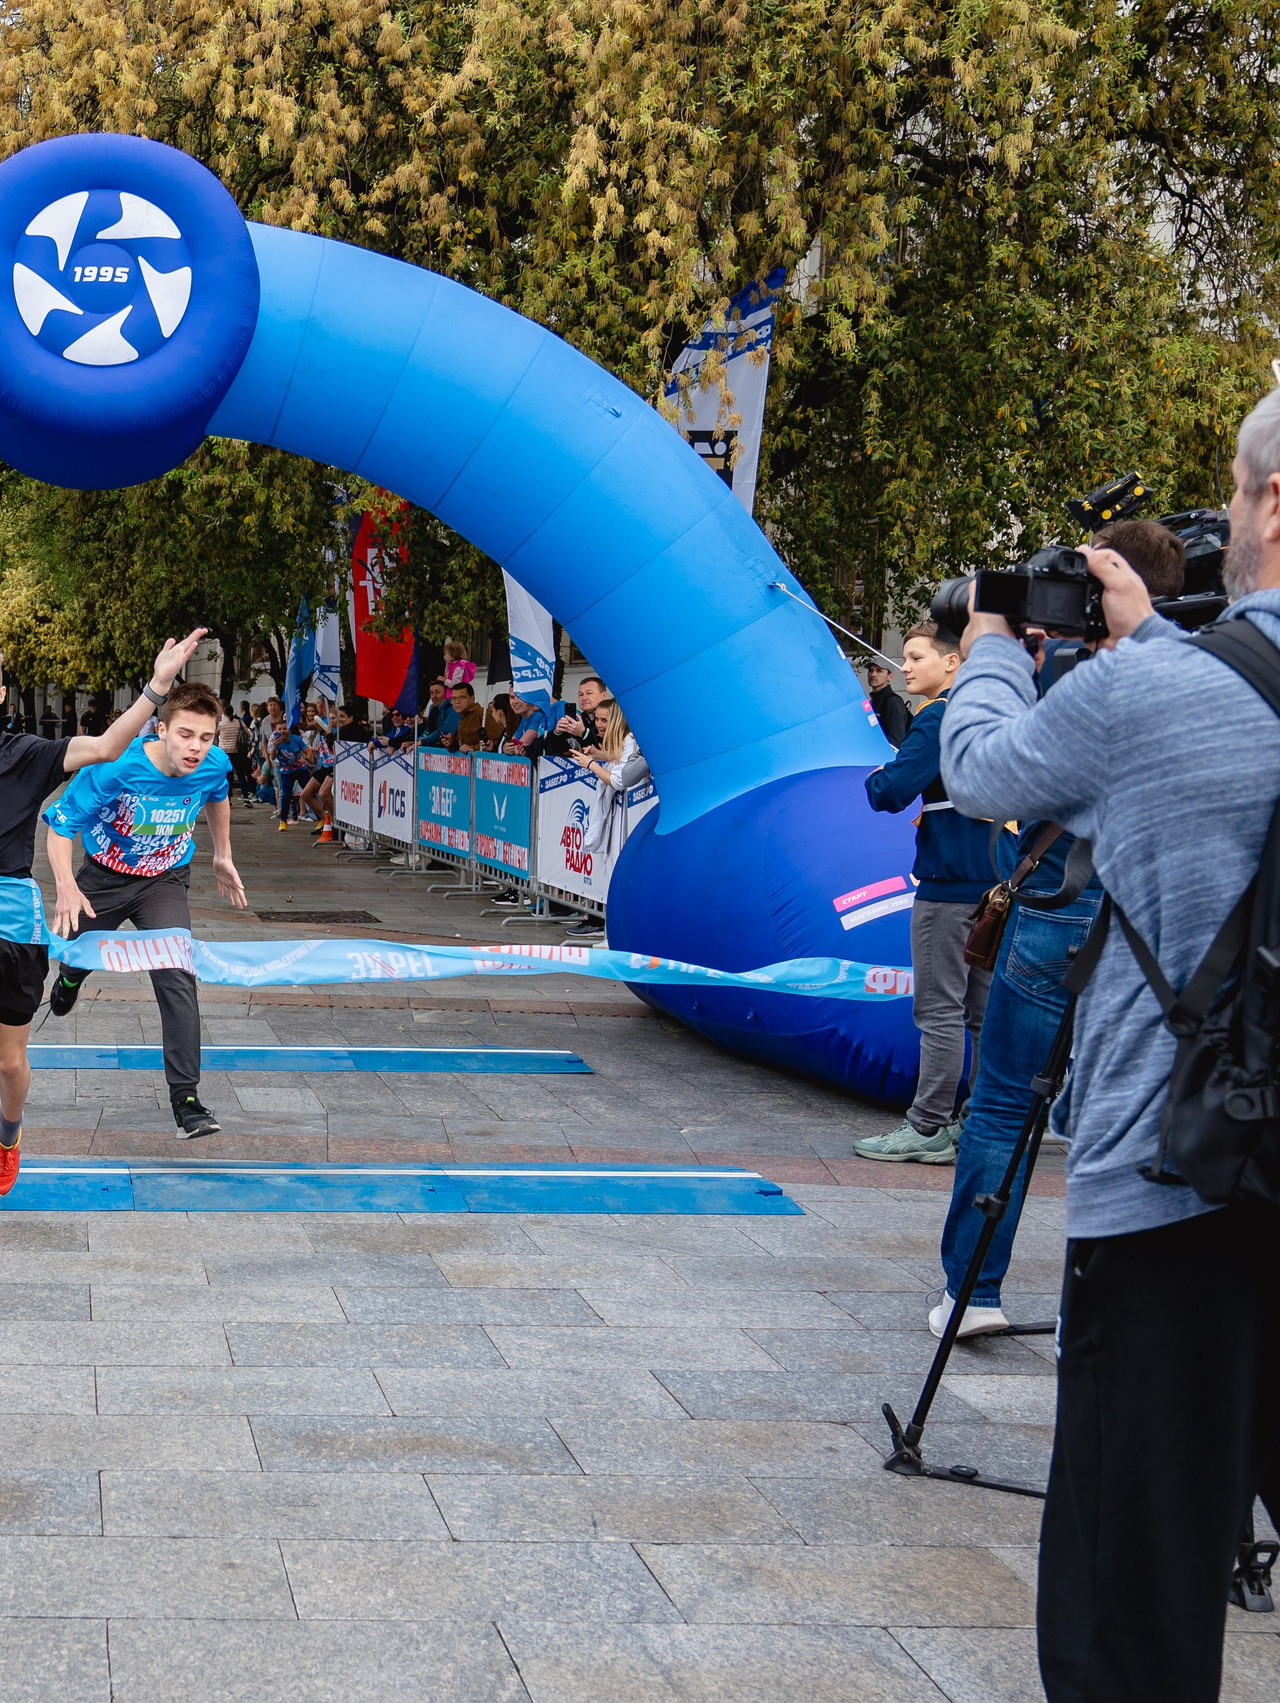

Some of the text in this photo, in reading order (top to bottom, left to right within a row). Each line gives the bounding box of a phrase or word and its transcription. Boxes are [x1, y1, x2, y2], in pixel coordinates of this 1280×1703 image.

[74, 266, 129, 283] 1995
[341, 780, 363, 805] FONBET
[388, 788, 406, 818] ПСБ
[150, 809, 186, 823] 10251
[155, 824, 175, 835] 1KM
[560, 826, 582, 850] АВТО
[566, 848, 593, 876] РАДИО
[842, 891, 867, 905] СТАРТ
[850, 904, 889, 923] МАГАЗИН
